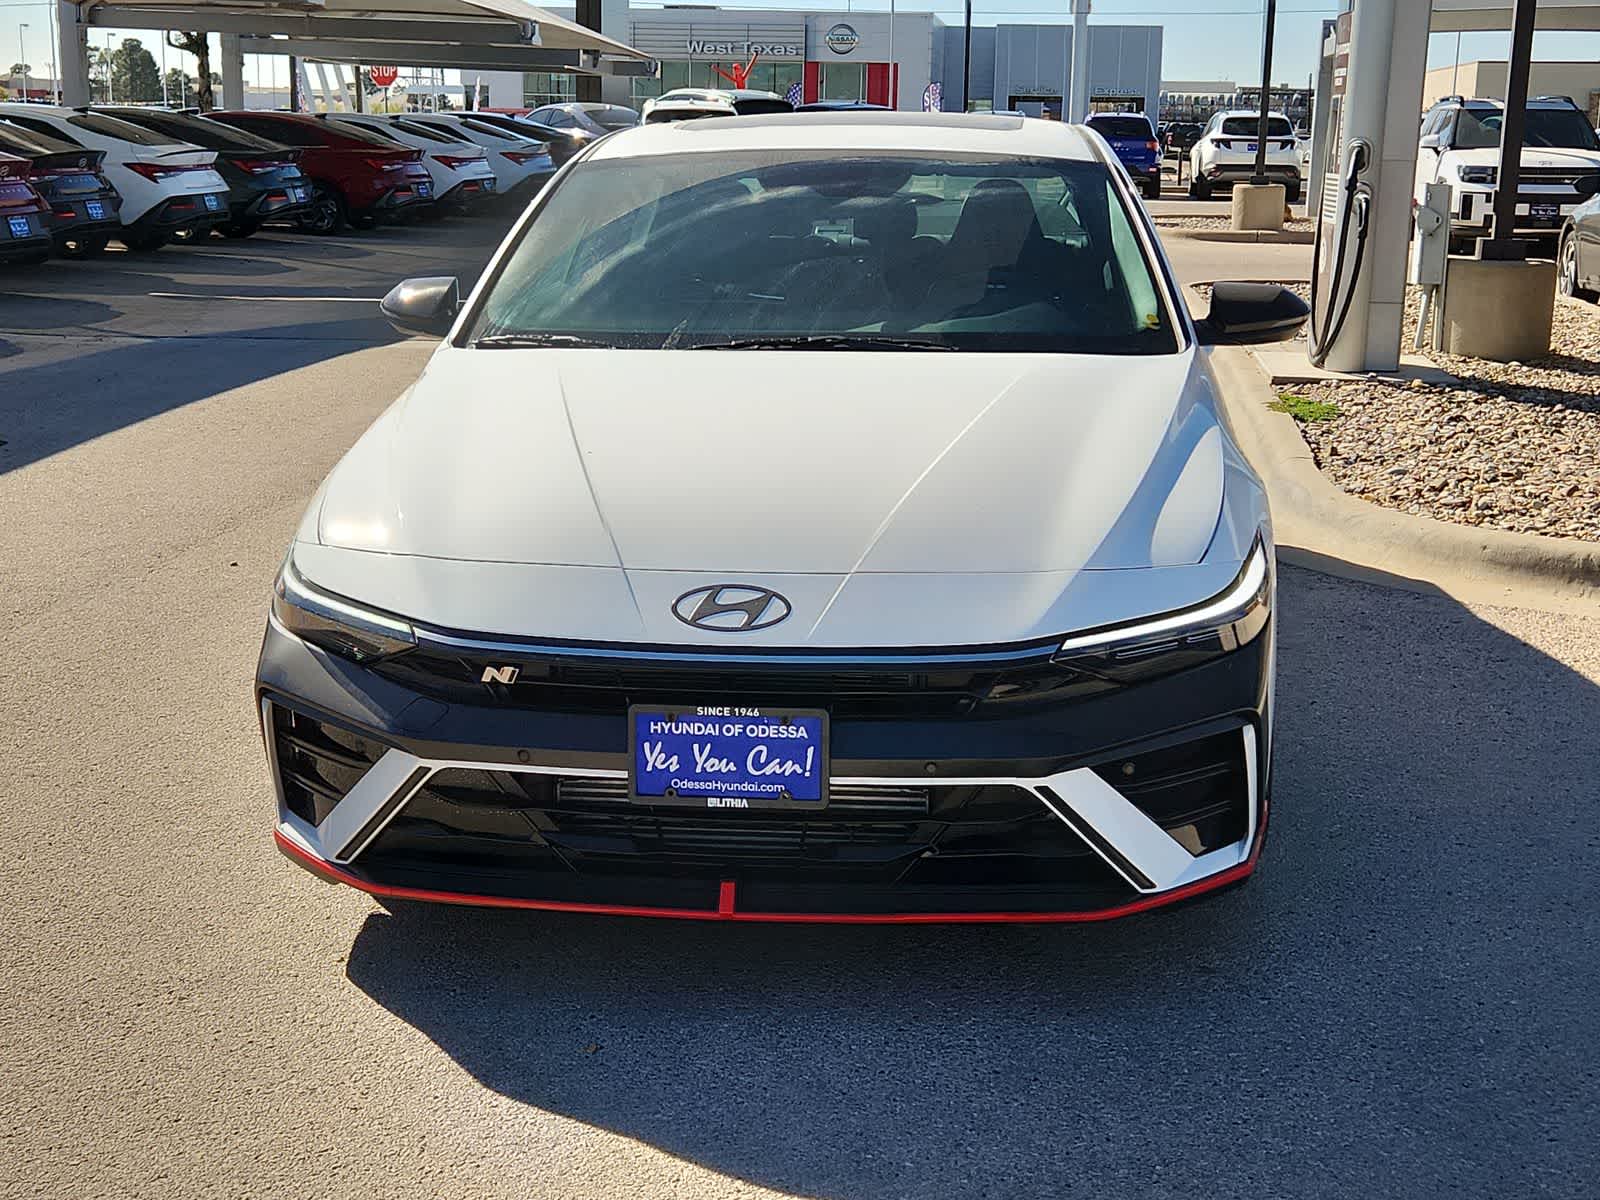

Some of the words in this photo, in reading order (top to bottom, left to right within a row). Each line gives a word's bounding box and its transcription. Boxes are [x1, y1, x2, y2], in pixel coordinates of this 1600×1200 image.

[828, 35, 857, 43] NISSAN
[686, 40, 734, 55] West
[743, 41, 798, 56] Texas
[372, 65, 396, 76] STOP
[696, 706, 731, 717] SINCE
[734, 707, 760, 717] 1946
[650, 722, 719, 736] HYUNDAI
[722, 724, 744, 737] OF
[746, 725, 809, 739] ODESSA
[643, 741, 680, 773] Yes
[692, 743, 737, 774] You
[746, 744, 815, 777] Can!
[671, 778, 785, 793] OdessaHyundai.com
[716, 797, 749, 808] LITHIA
